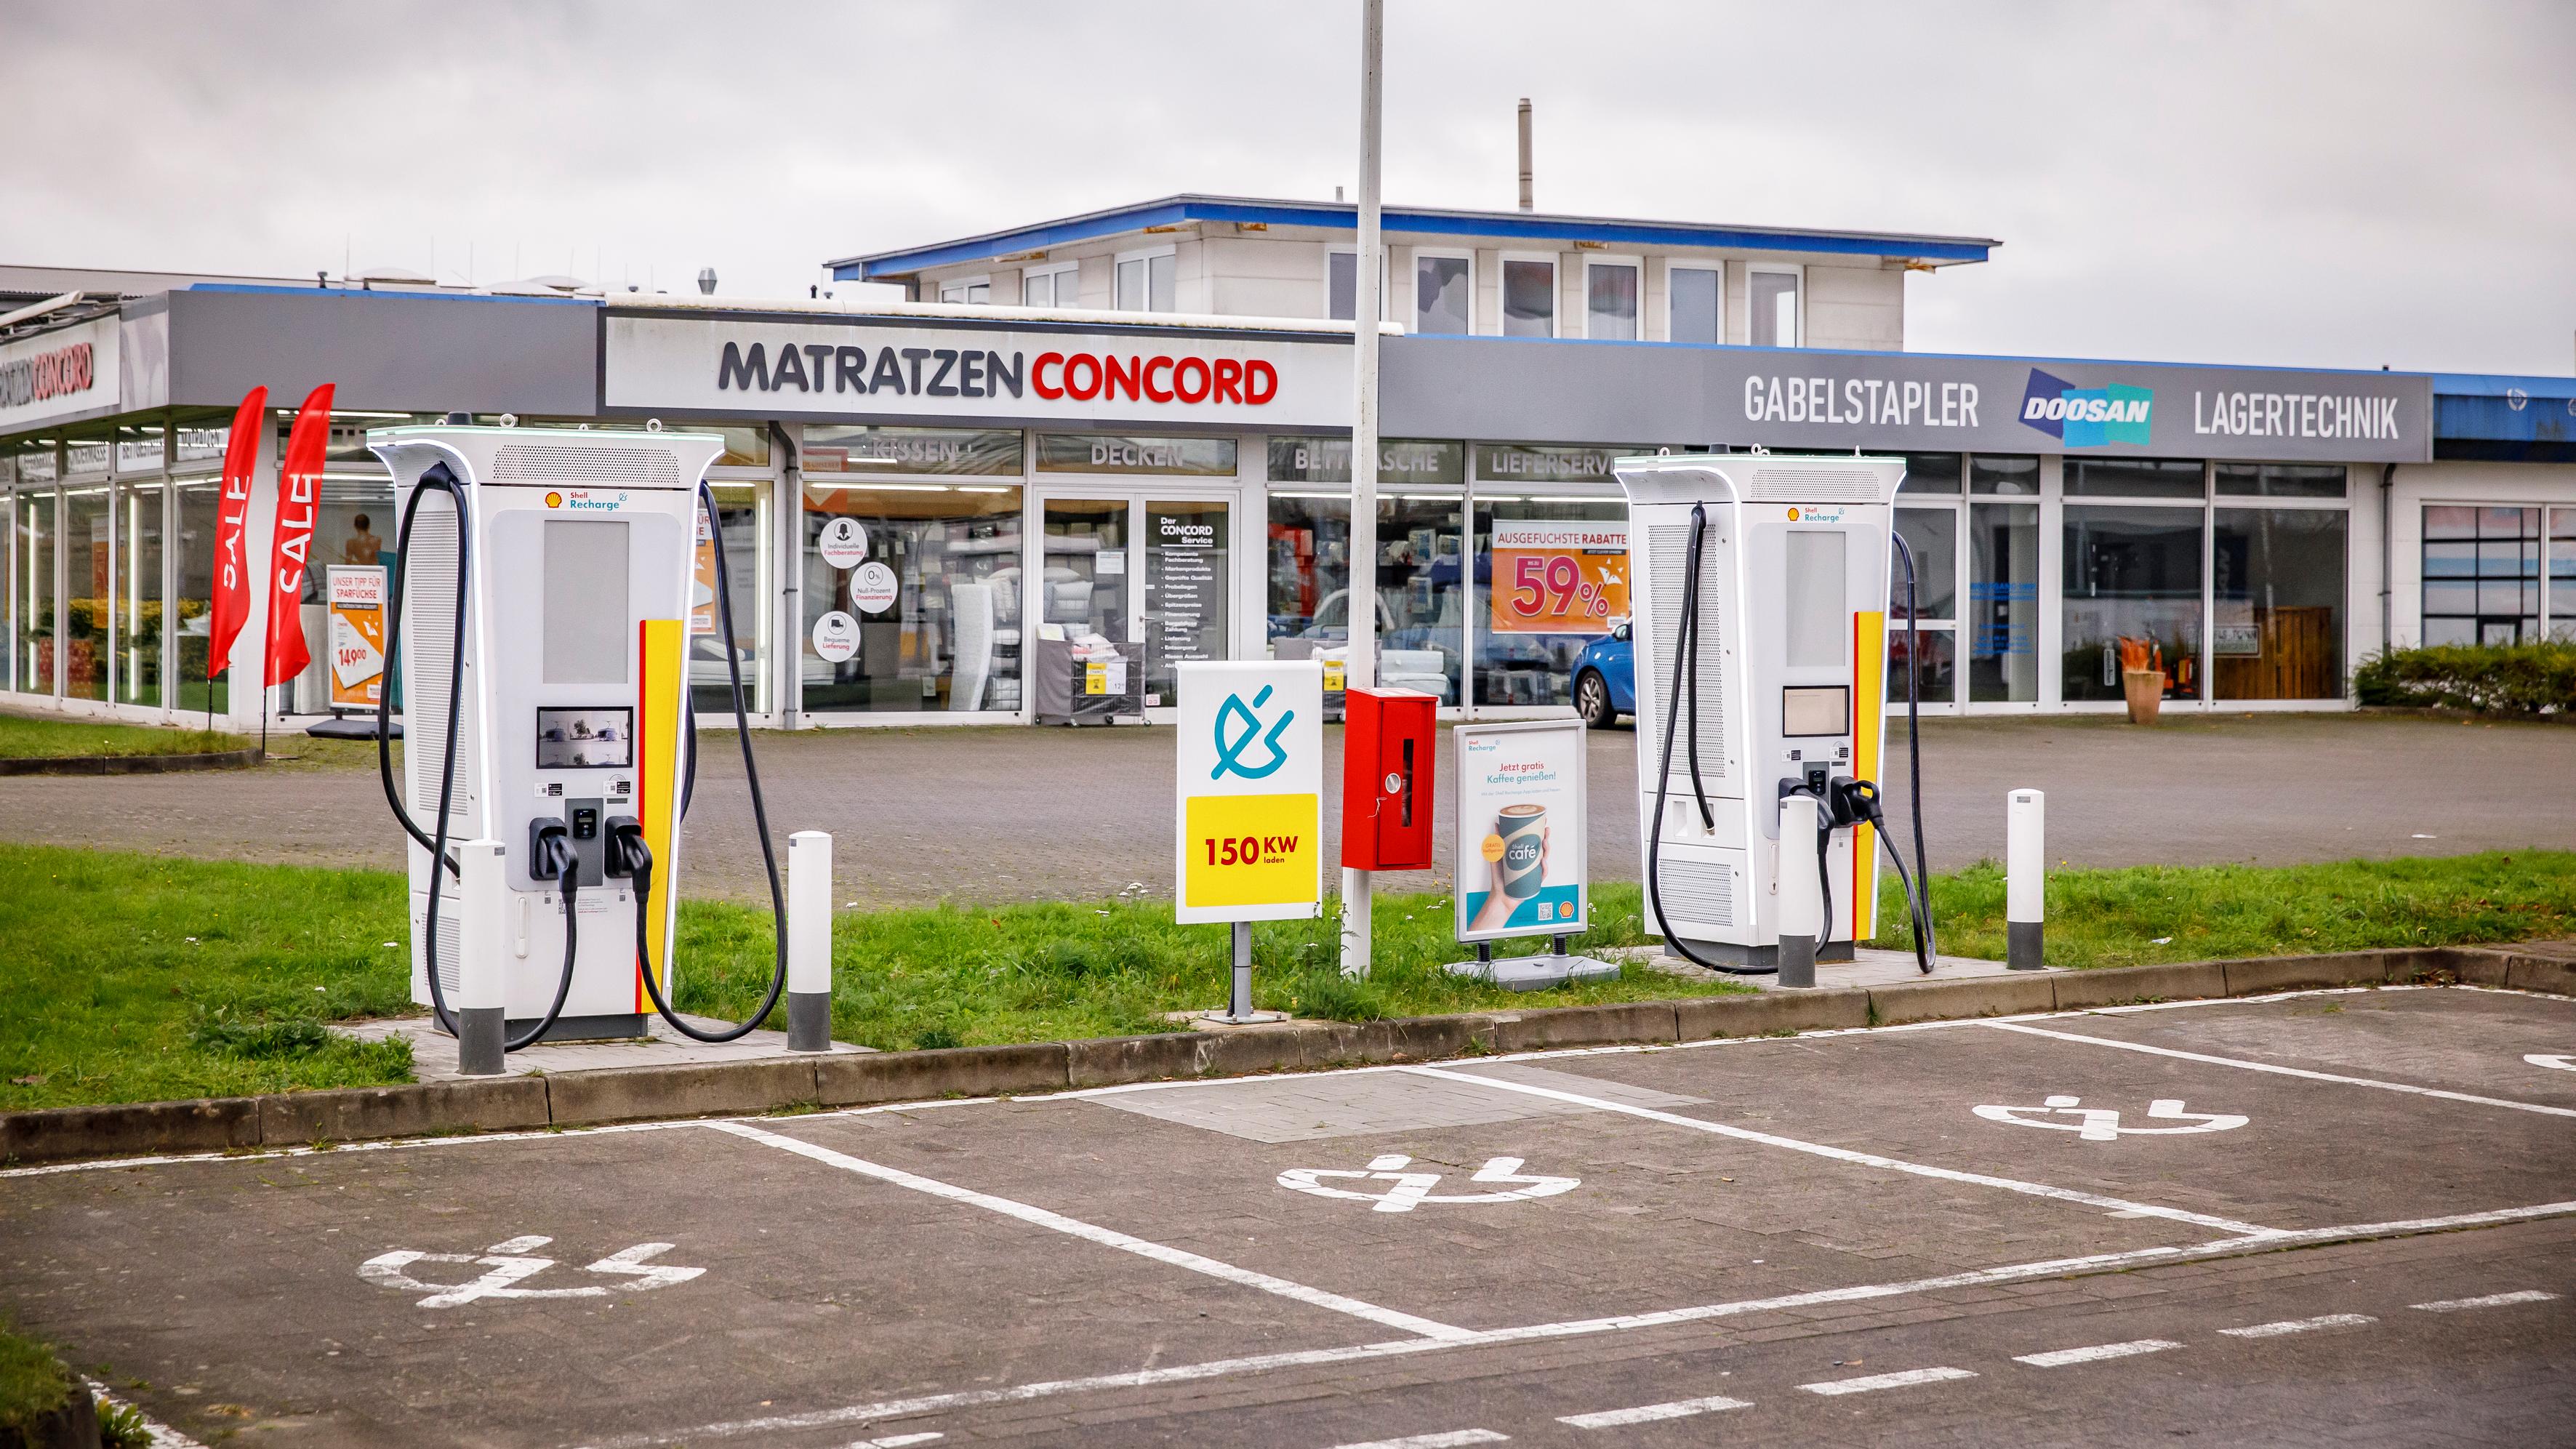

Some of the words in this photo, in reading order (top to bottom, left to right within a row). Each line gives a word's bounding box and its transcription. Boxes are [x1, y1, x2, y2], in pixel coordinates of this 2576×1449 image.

[33, 342, 94, 400] CONCORD
[718, 341, 1024, 398] MATRATZEN
[1032, 352, 1277, 405] CONCORD
[1744, 375, 1979, 428] GABELSTAPLER
[2023, 397, 2151, 423] DOOSAN
[2194, 390, 2399, 440] LAGERTECHNIK
[872, 438, 956, 463] KISSEN
[1091, 444, 1184, 467] DECKEN
[1295, 448, 1438, 473] BETTSCHE
[1492, 452, 1614, 476] LIEFERSERVI
[570, 499, 619, 511] Recharge
[1805, 513, 1839, 523] Recharge
[1160, 526, 1213, 536] CONCORD
[1498, 533, 1580, 545] AUSGEFUCHSTE
[1582, 534, 1627, 545] RABATTE
[332, 576, 353, 587] UNSER
[354, 577, 367, 587] TIPP
[369, 575, 381, 587] FÜR
[1511, 555, 1610, 617] 59%
[336, 587, 377, 599] SPARFÜCHSE
[1487, 773, 1514, 784] Kaffee
[1517, 771, 1557, 784] genießen!
[1499, 763, 1520, 772] Jetzt
[1521, 760, 1544, 773] gratis
[1205, 836, 1260, 866] 150
[1264, 835, 1299, 854] KW
[1509, 845, 1537, 860] café
